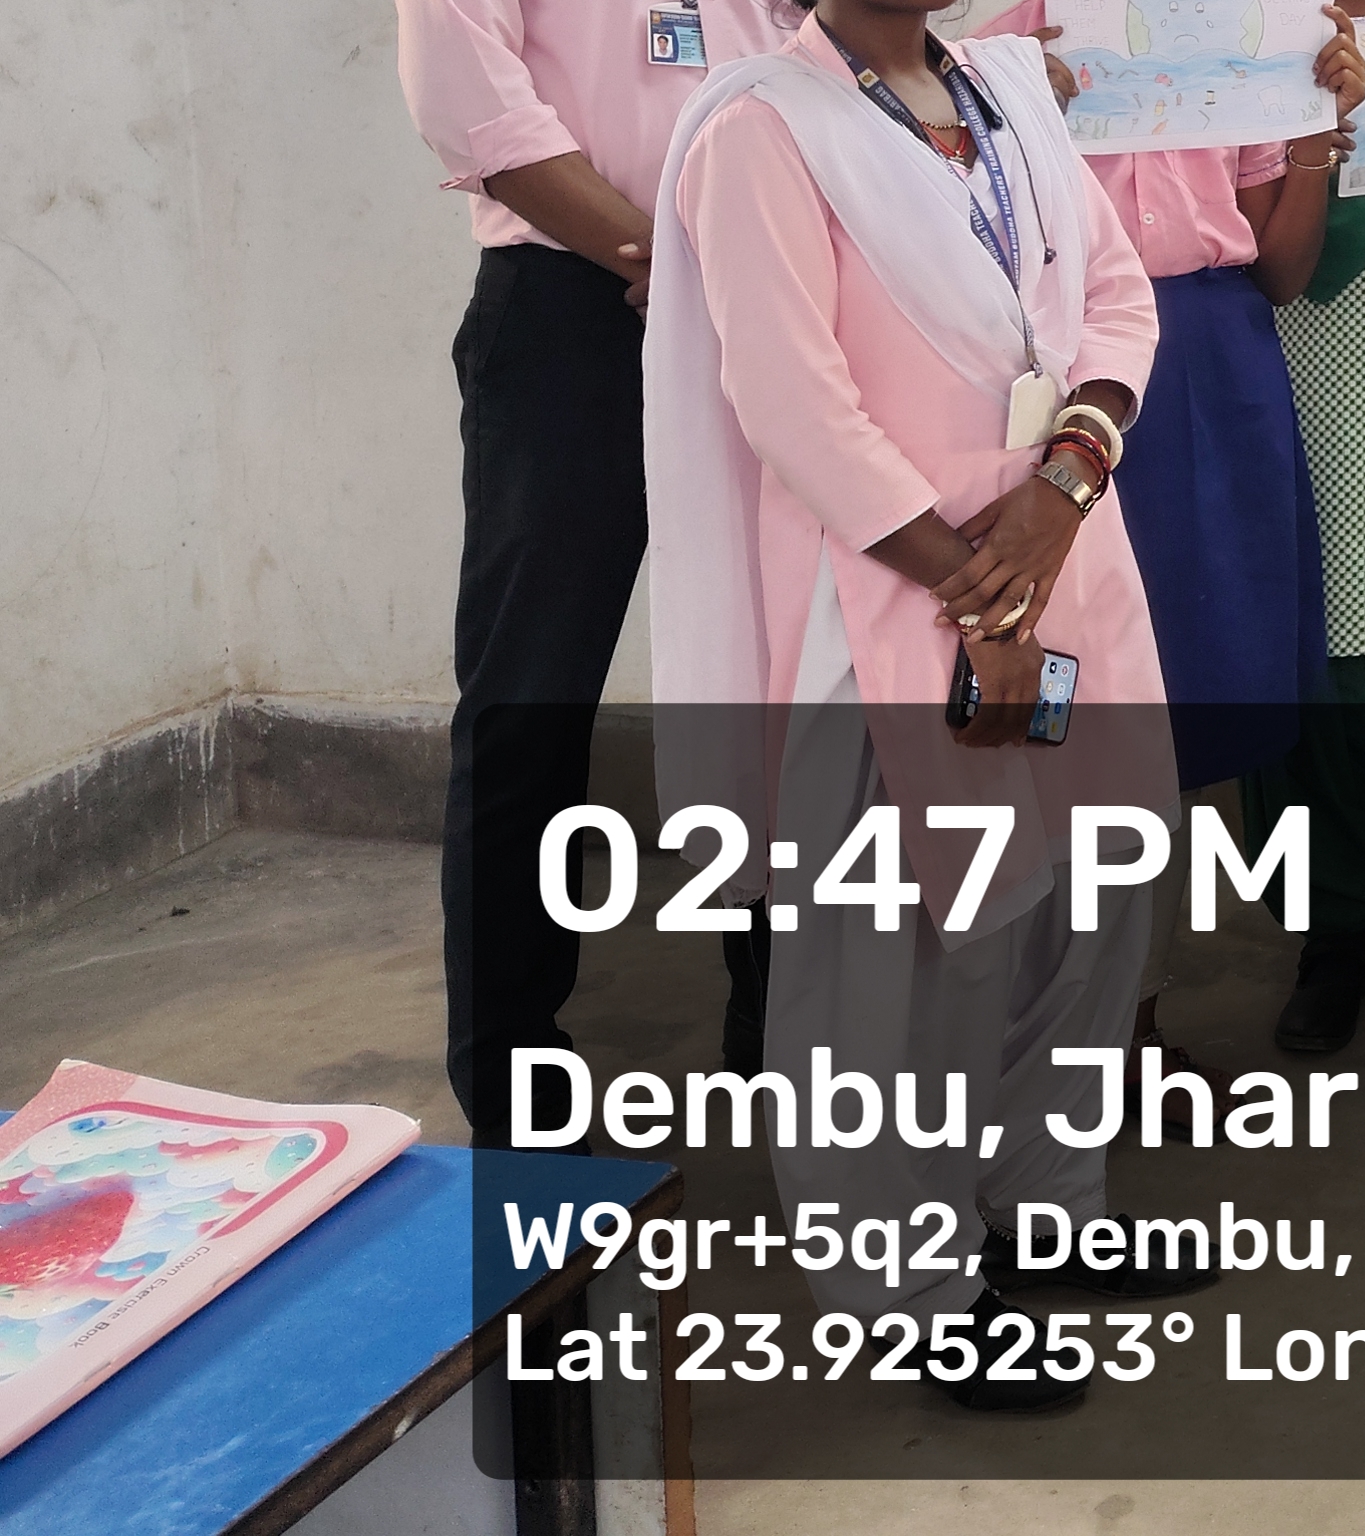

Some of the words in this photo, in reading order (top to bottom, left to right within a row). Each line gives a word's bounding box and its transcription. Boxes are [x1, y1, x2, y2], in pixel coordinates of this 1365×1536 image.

[1074, 0, 1107, 12] HELP
[1279, 12, 1307, 27] DAY
[165, 1244, 211, 1278] Crown
[109, 1275, 170, 1321] Exercise
[69, 1319, 112, 1350] Book
